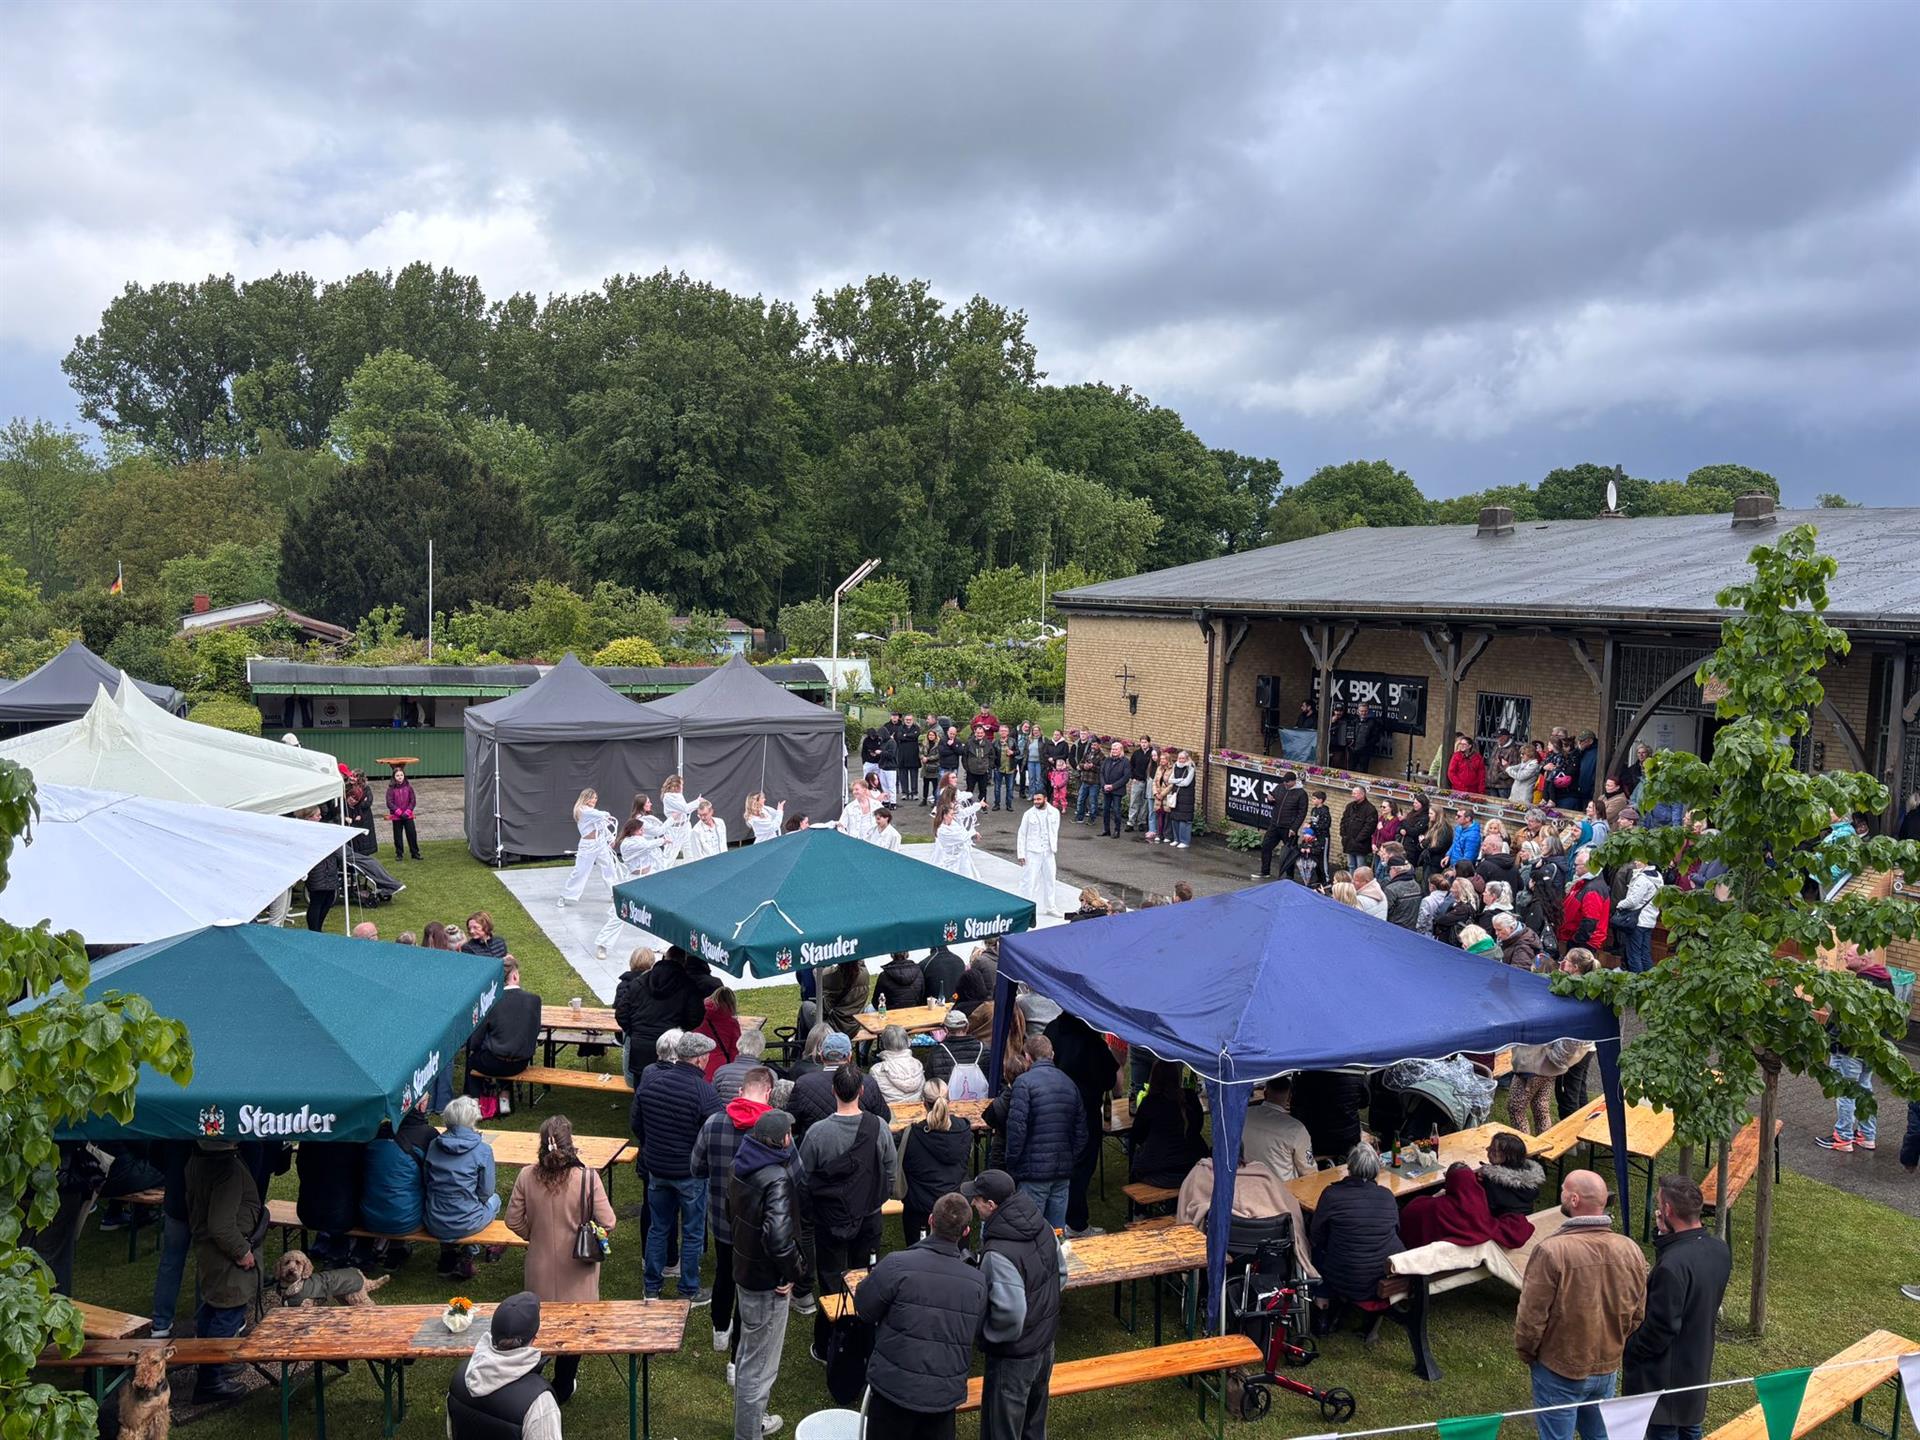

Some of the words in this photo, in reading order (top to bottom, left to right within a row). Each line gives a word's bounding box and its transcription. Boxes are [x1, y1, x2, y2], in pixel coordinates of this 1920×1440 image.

[1350, 681, 1381, 704] BBK
[1230, 774, 1259, 801] BBK
[1228, 802, 1260, 814] KOLLEKTIV
[1260, 810, 1272, 818] KOL
[629, 900, 652, 928] Stauder
[964, 914, 1013, 939] Stauder
[701, 933, 729, 966] Stauder
[800, 935, 858, 965] Stauder
[413, 1050, 440, 1100] Stauder
[238, 1104, 336, 1138] Stauder
